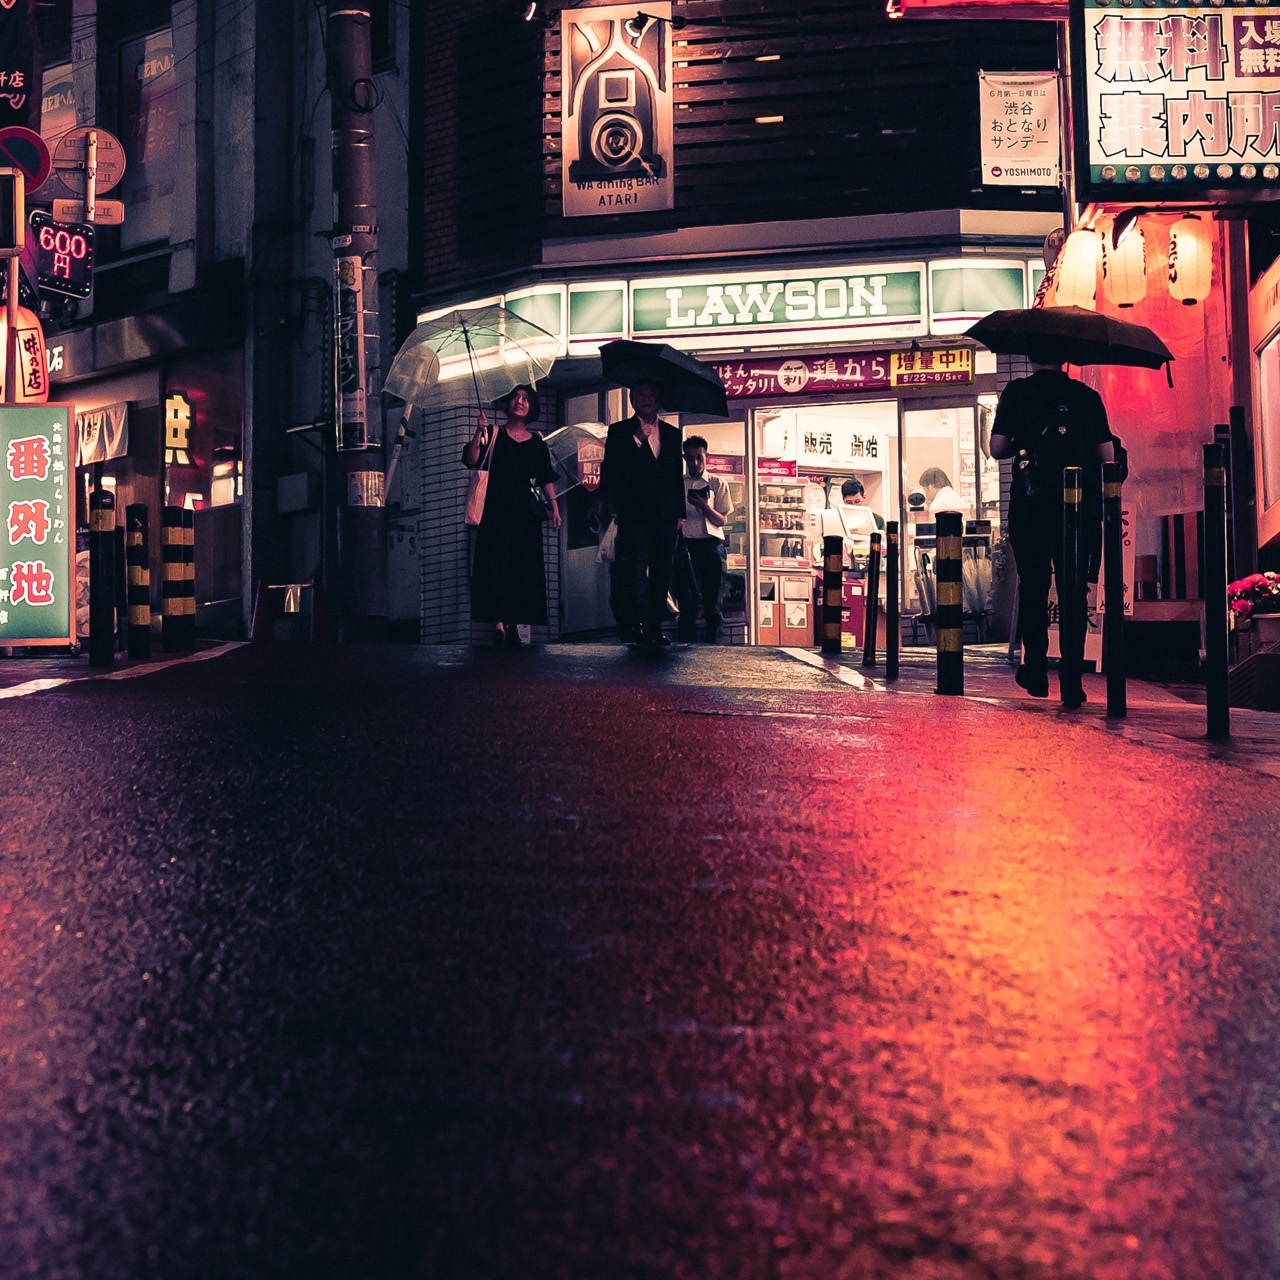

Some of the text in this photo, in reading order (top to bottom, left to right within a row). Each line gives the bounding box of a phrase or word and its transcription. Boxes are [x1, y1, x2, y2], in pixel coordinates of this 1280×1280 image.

[1094, 14, 1230, 83] 無料
[1004, 101, 1034, 116] 渋谷
[991, 118, 1047, 133] おとなり
[991, 134, 1049, 149] サンデー
[636, 176, 660, 188] BAR
[1004, 167, 1052, 177] YOSHIMOTO
[598, 192, 638, 207] ATARI
[38, 226, 87, 259] 600
[53, 252, 71, 279] 円
[665, 275, 888, 327] LAWSON
[896, 350, 972, 371] 増量中!!
[782, 365, 805, 386] 新
[804, 432, 879, 459] 販売 開始
[582, 476, 601, 485] ATM
[7, 434, 55, 606] 番外地
